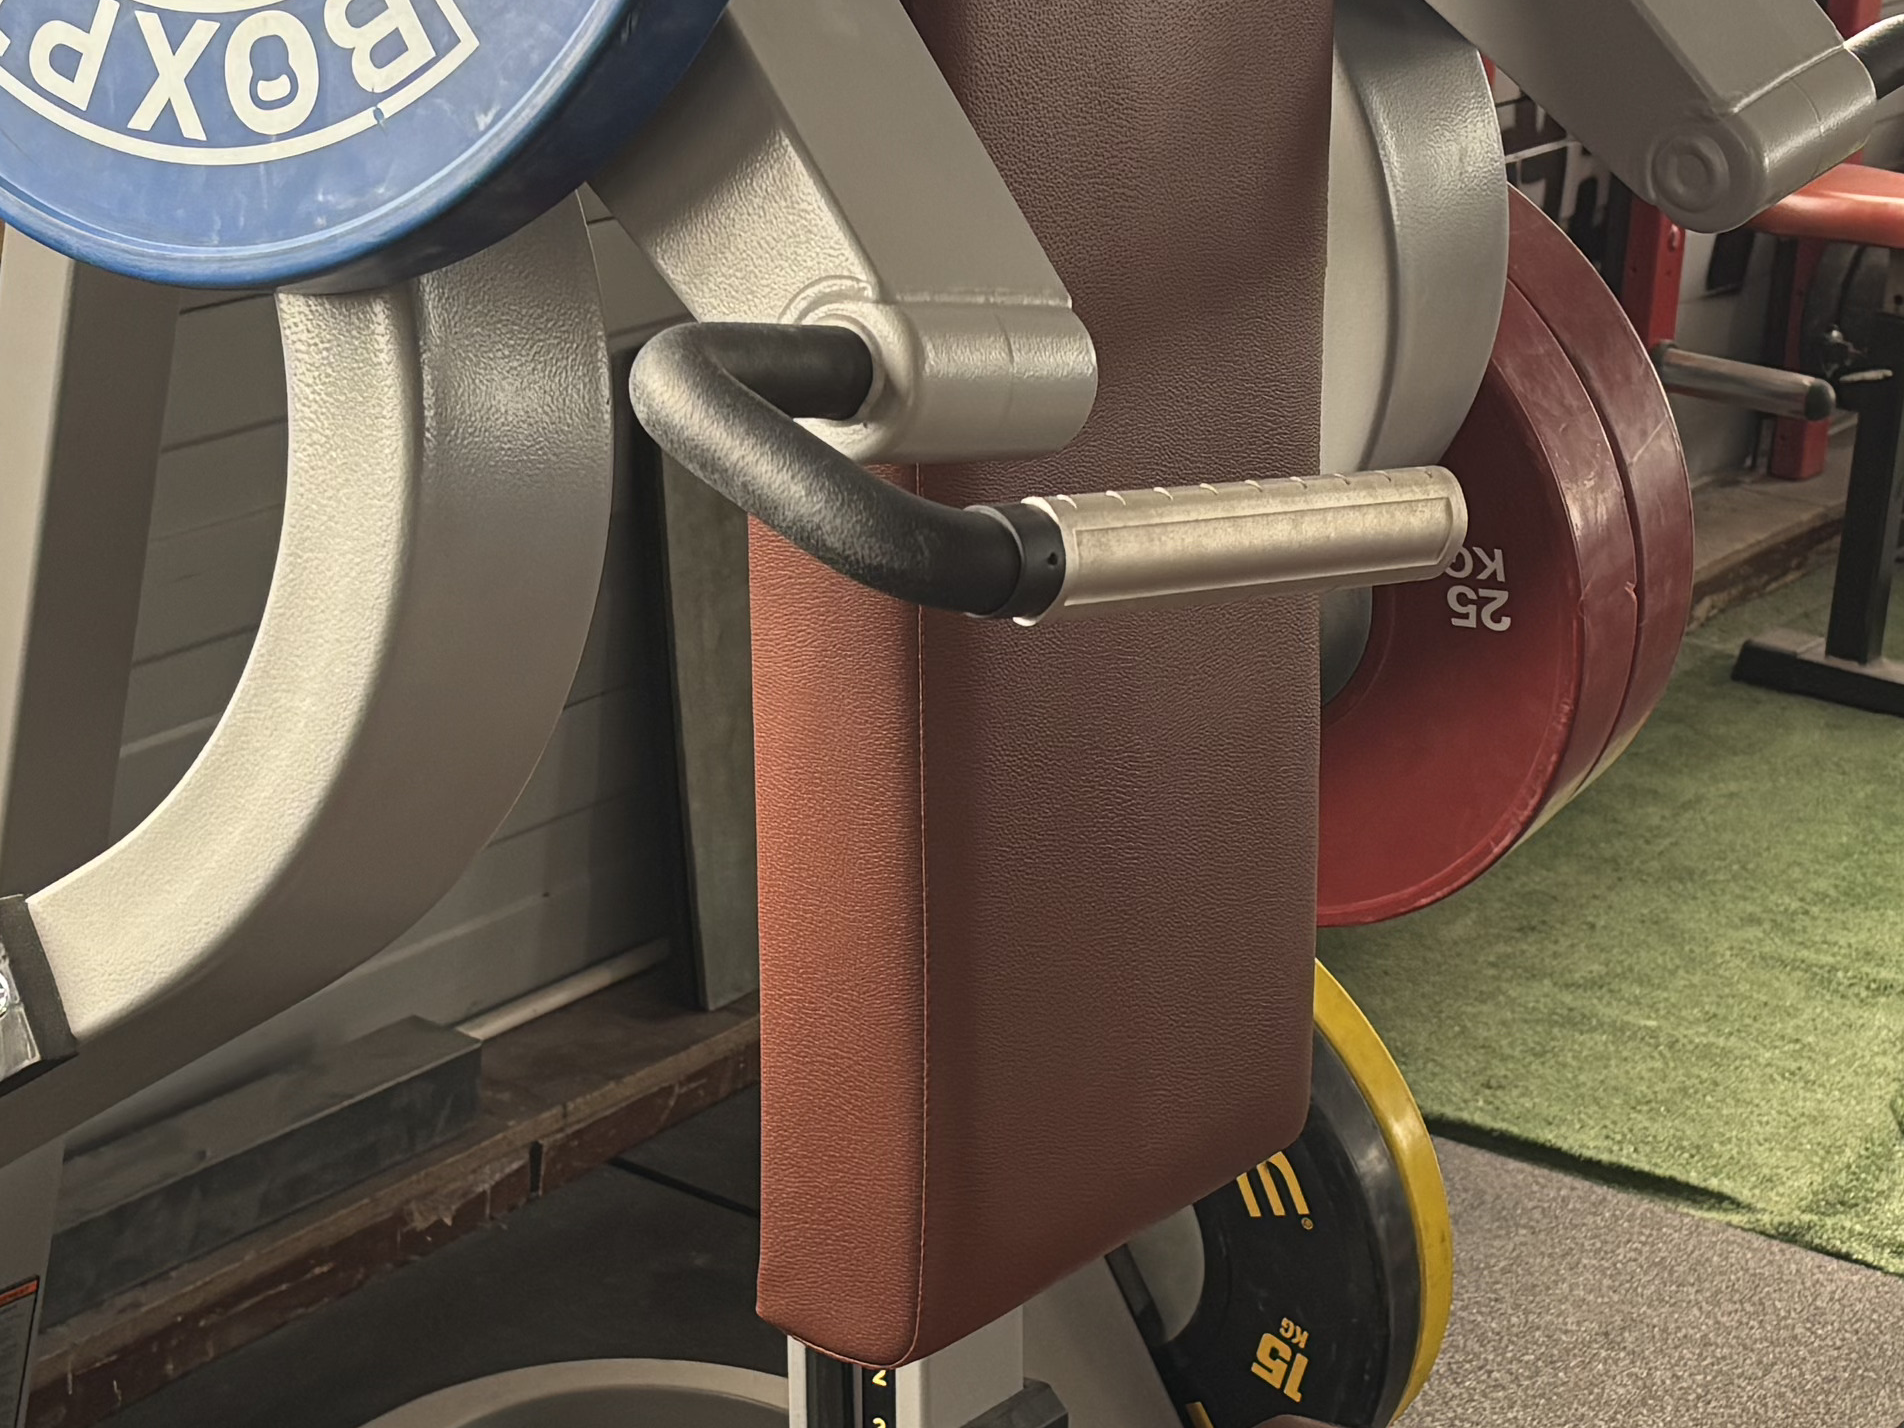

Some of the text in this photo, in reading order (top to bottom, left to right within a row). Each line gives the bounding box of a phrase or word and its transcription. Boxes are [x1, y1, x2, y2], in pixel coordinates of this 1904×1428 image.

[1446, 584, 1512, 632] 25
[1278, 1316, 1309, 1349] KG
[1250, 1332, 1310, 1403] 15
